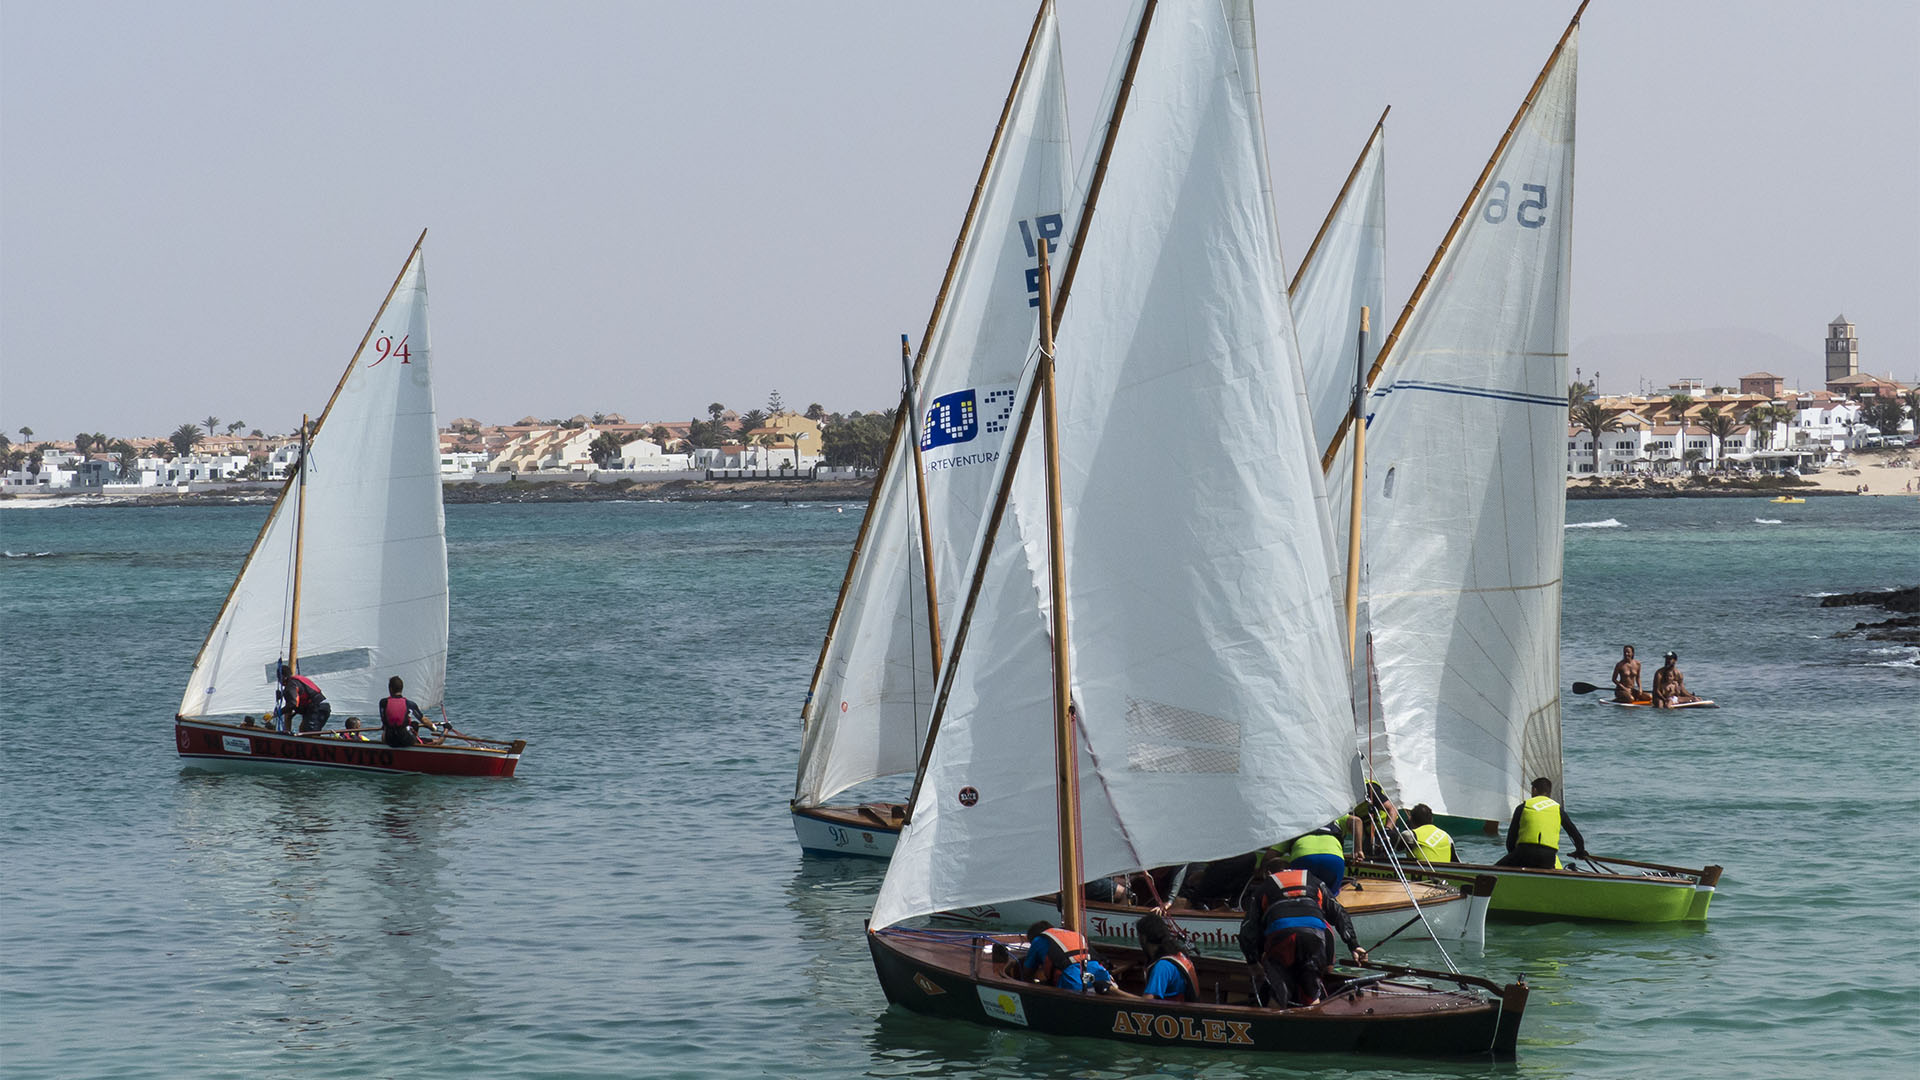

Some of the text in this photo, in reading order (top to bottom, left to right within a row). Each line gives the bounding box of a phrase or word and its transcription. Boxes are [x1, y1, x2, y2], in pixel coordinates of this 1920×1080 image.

[368, 334, 412, 368] 94
[928, 451, 1000, 473] RTEVENTURA
[1111, 1010, 1255, 1045] AYOLEX
